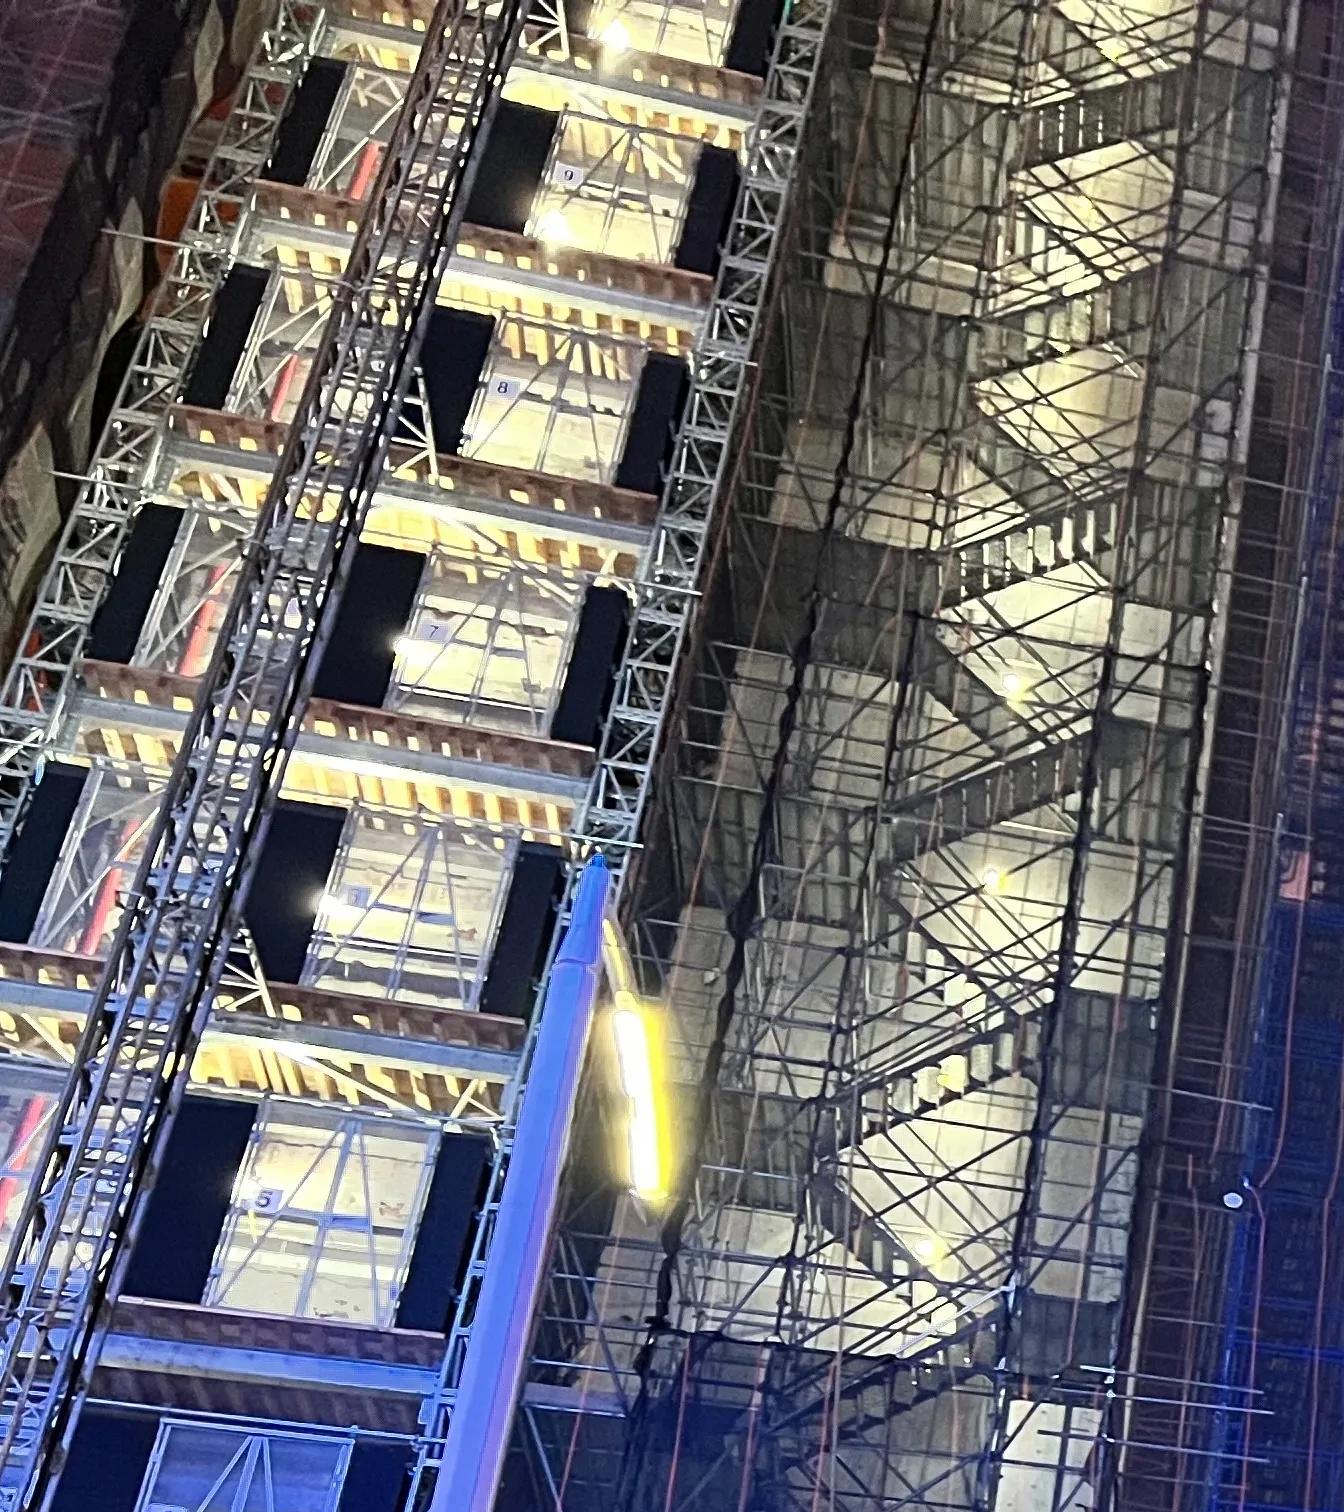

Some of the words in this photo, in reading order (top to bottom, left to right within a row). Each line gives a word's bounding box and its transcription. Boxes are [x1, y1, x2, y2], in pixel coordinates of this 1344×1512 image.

[564, 169, 575, 182] 9
[497, 381, 508, 394] 8
[429, 624, 440, 639] 7
[255, 1190, 273, 1208] 5
